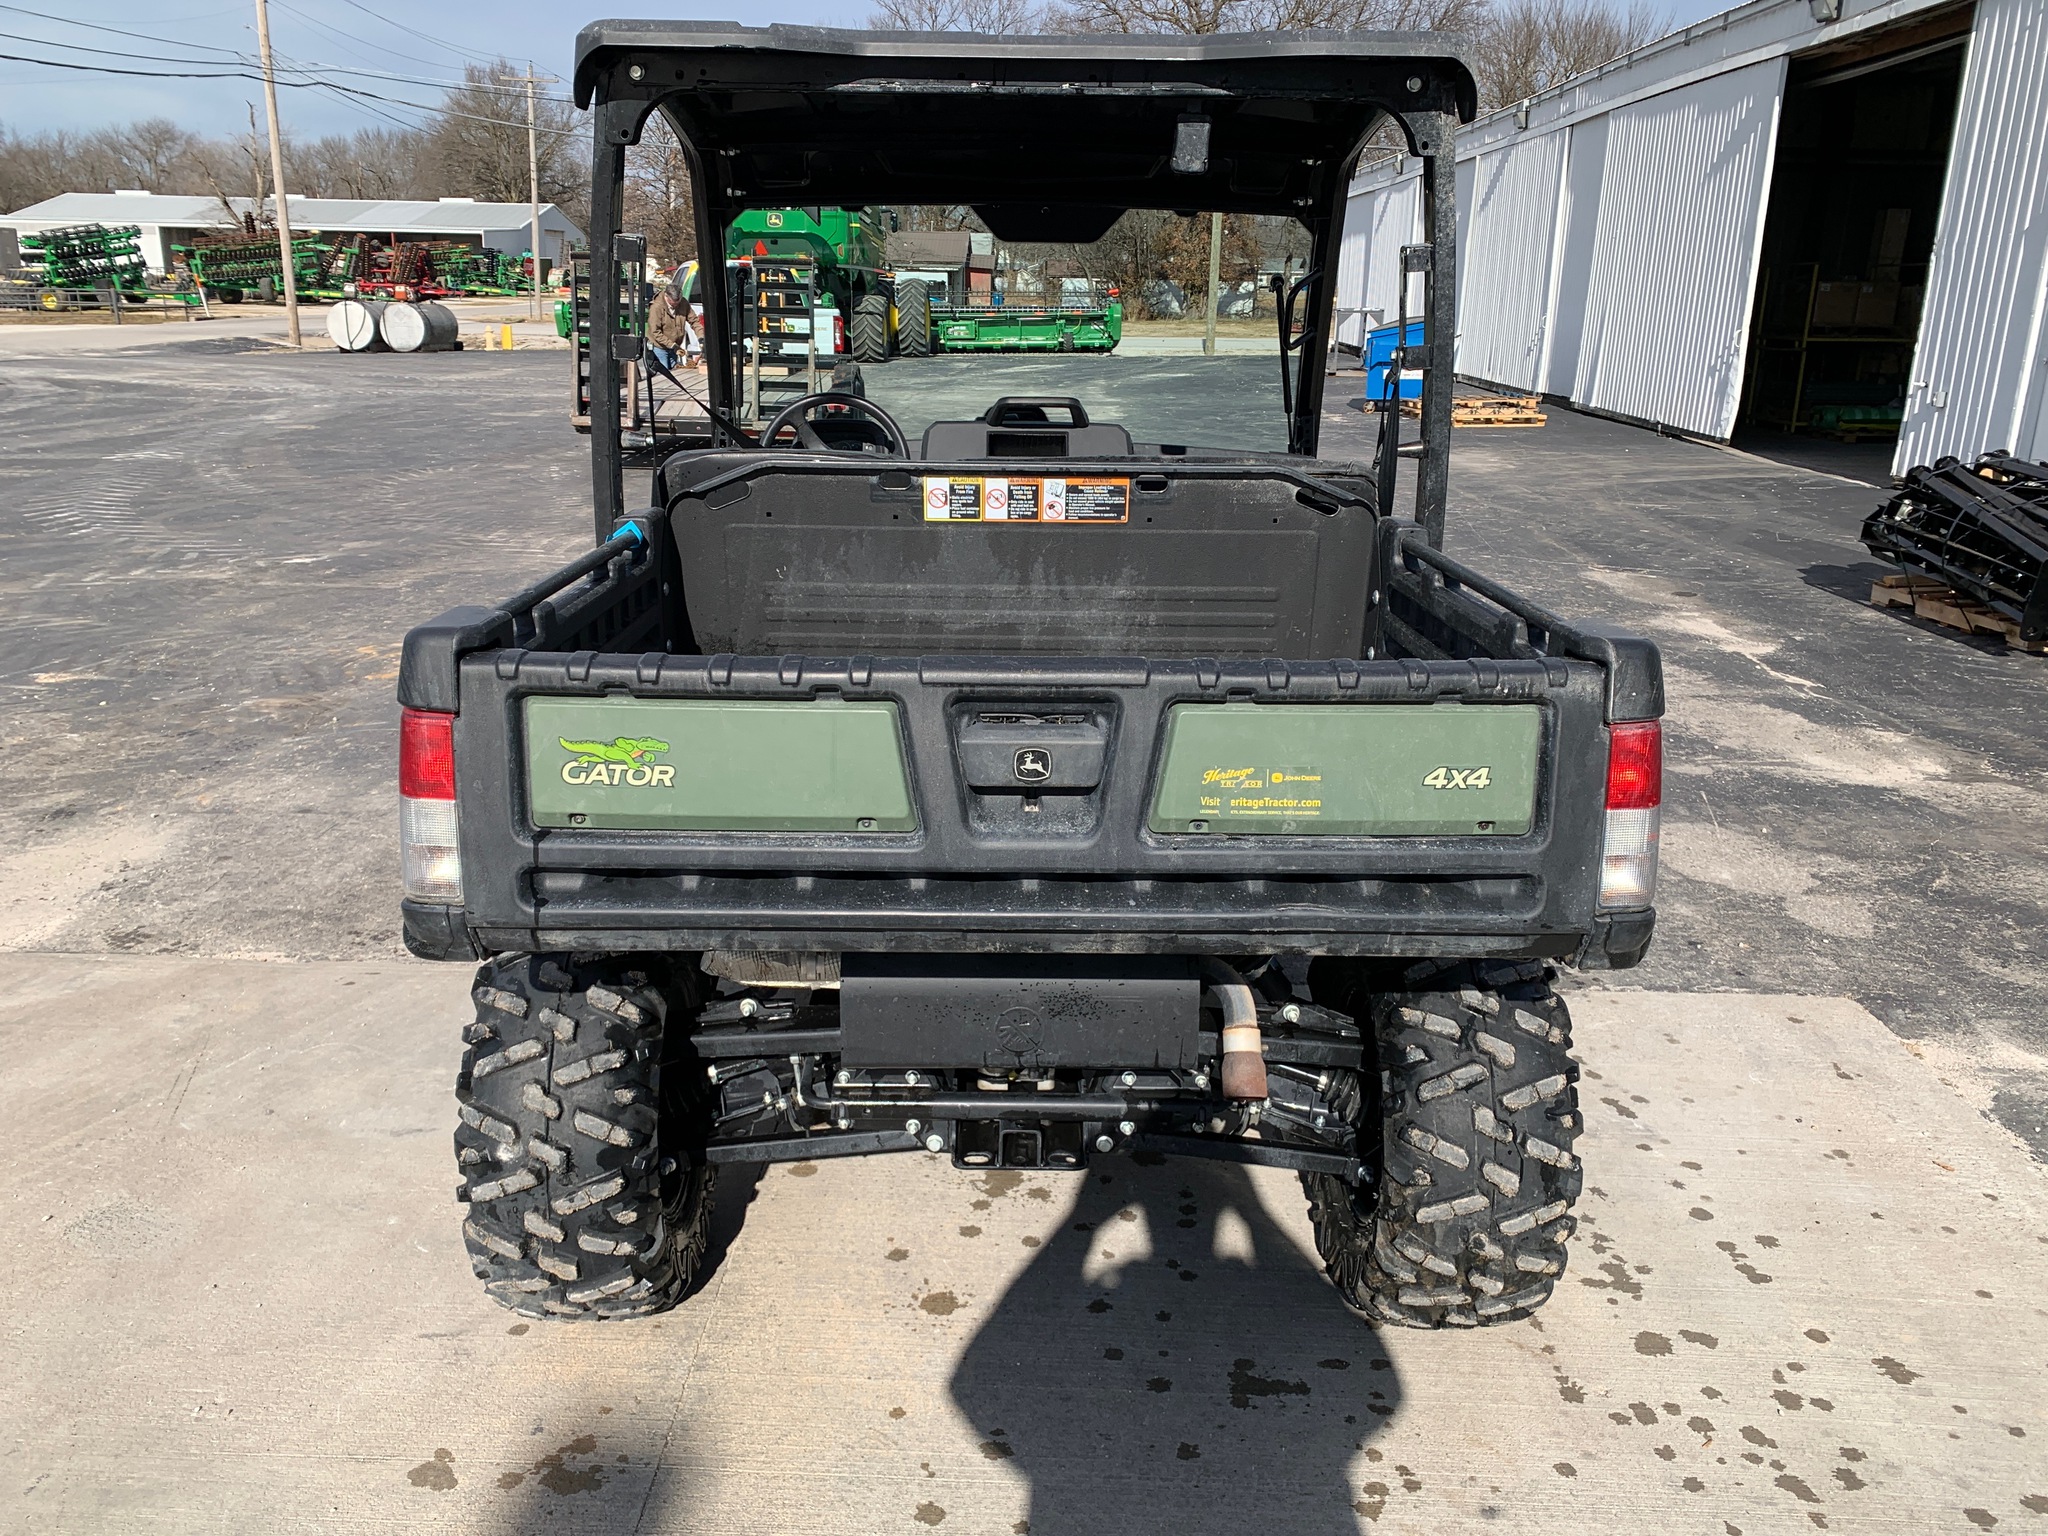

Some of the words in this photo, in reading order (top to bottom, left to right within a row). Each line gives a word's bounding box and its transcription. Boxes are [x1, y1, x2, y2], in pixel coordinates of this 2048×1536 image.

[561, 760, 677, 788] GATOR
[1201, 767, 1255, 784] Heritage
[1200, 796, 1221, 806] Visit
[1230, 797, 1321, 809] eritageTractor.com
